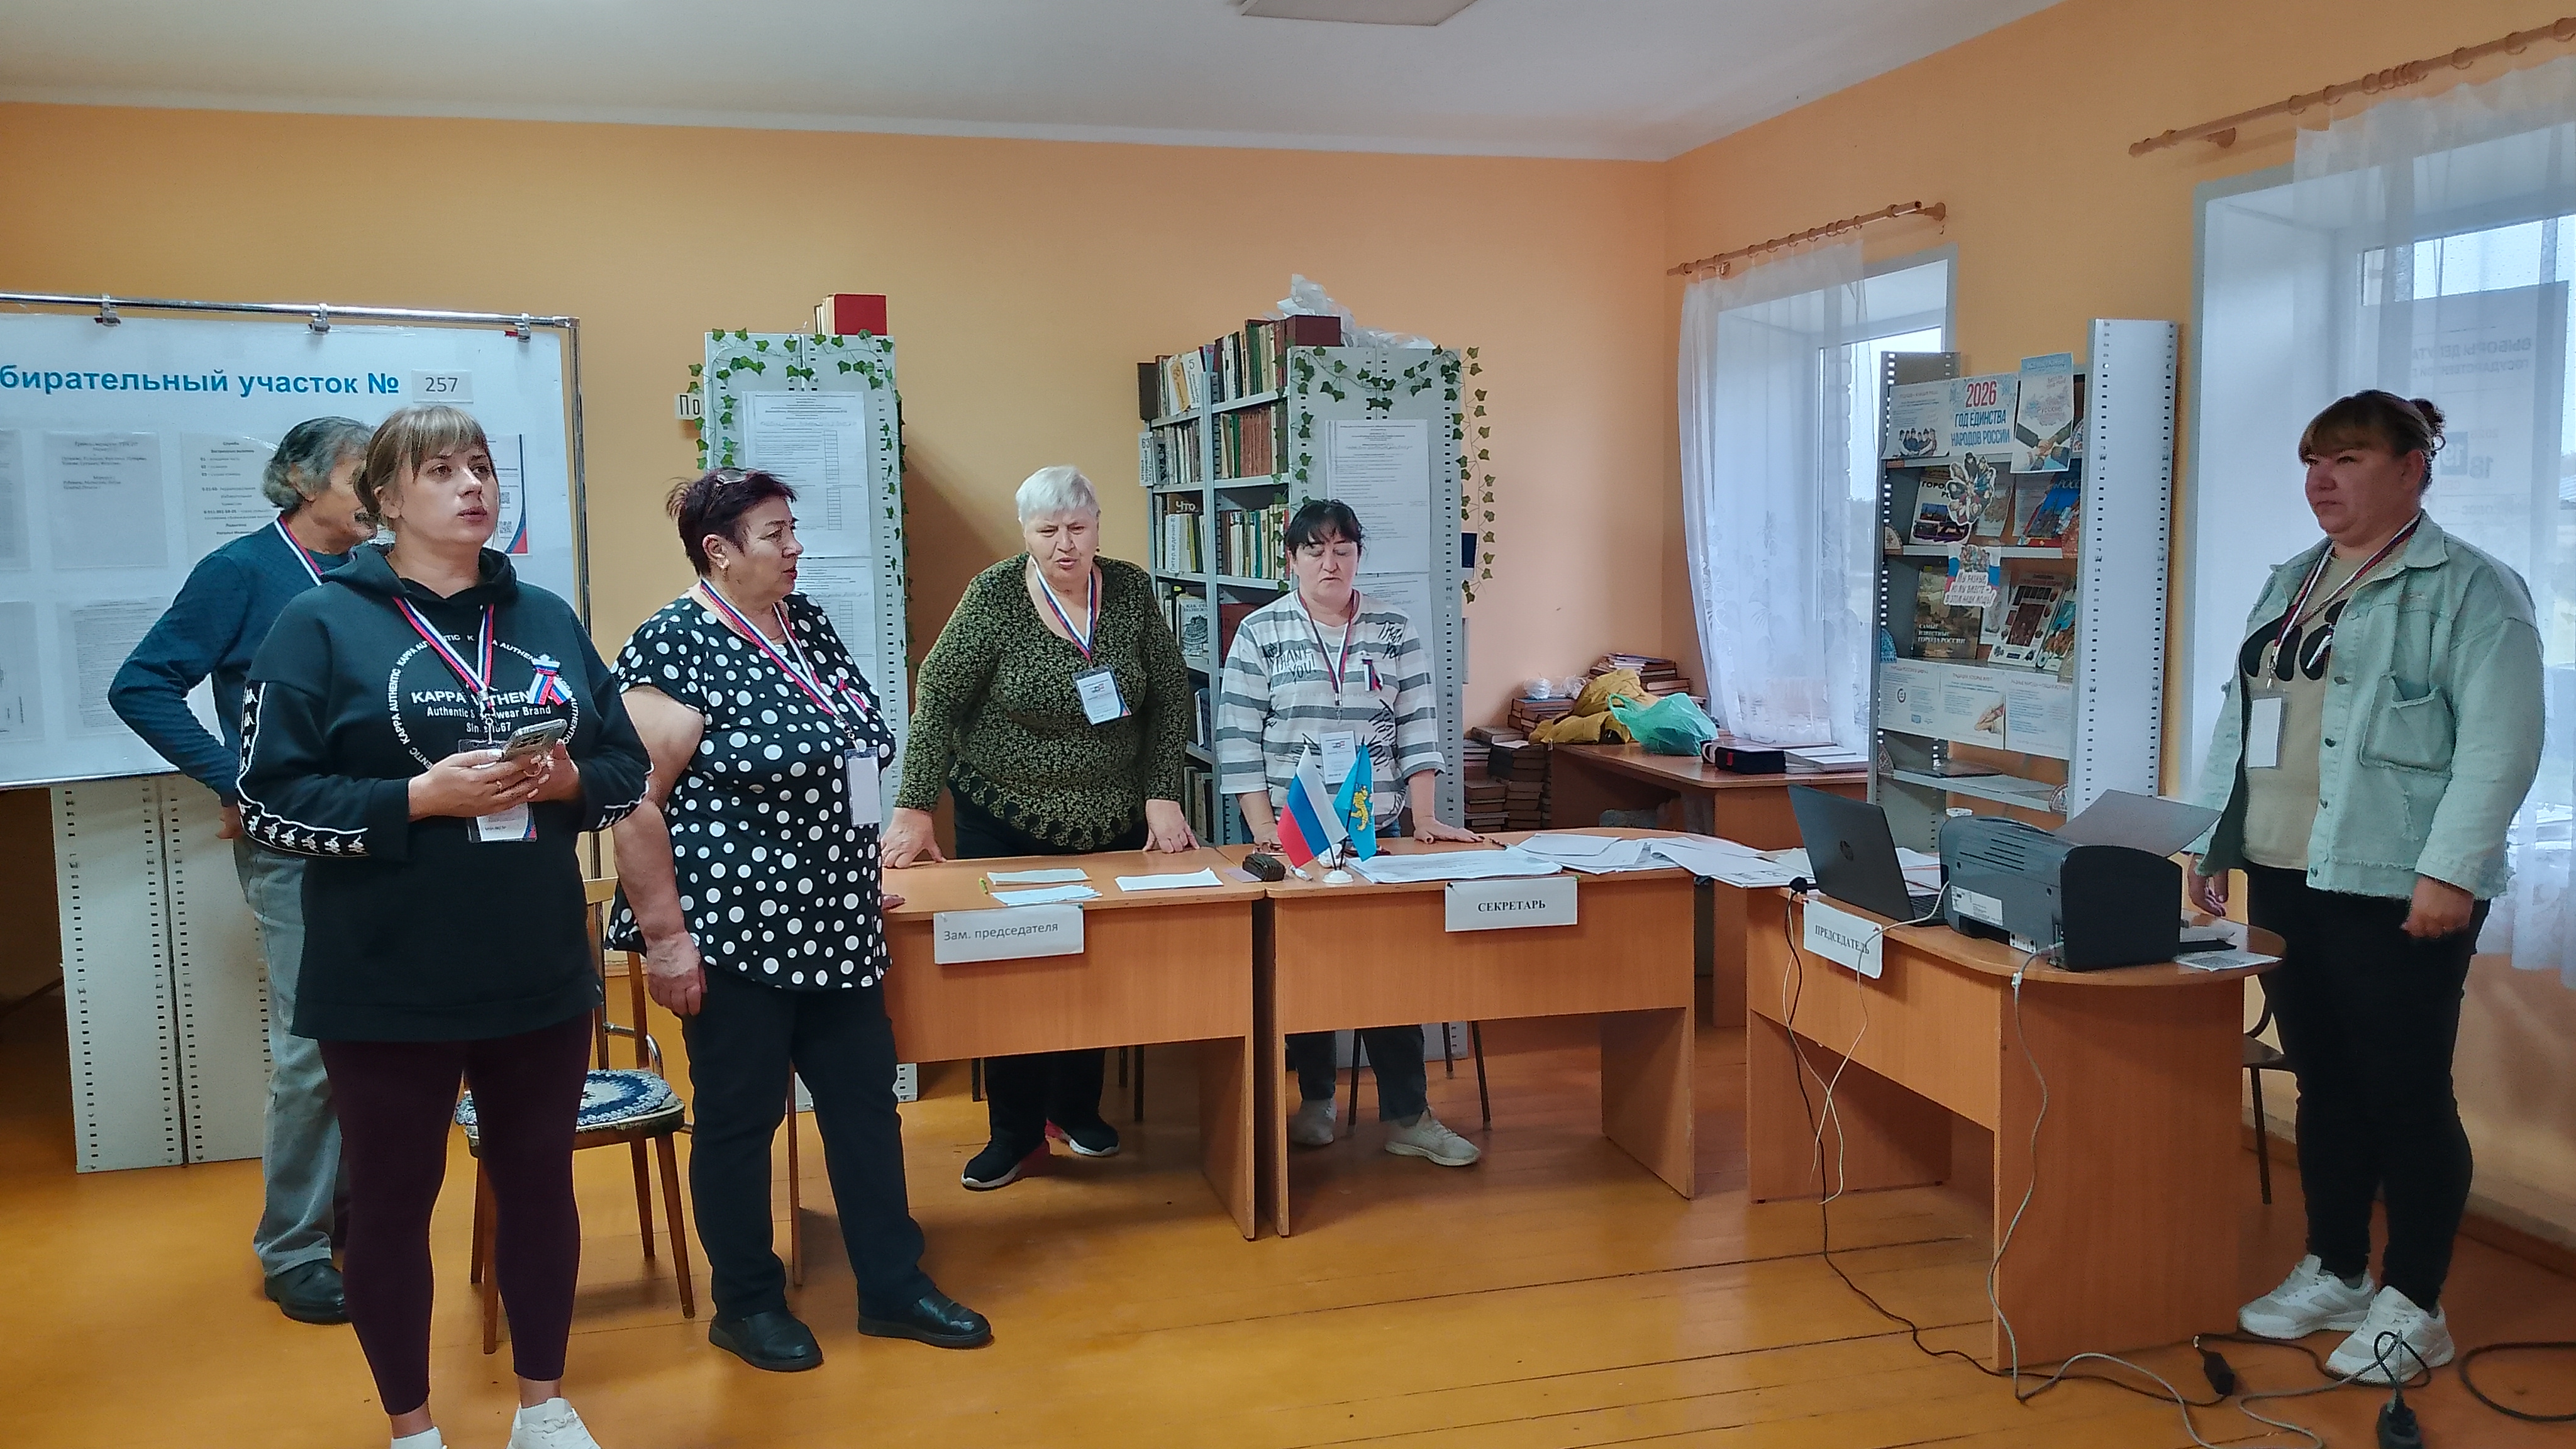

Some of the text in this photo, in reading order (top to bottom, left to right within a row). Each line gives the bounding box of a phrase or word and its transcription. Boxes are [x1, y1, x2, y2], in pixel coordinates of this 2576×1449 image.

[1189, 359, 1195, 369] 5
[0, 365, 458, 397] бирательный участок № 257
[1966, 380, 1997, 408] 2026
[1955, 413, 1968, 428] ГОД
[1970, 409, 2006, 426] ЕДИНСТВА
[1951, 428, 2010, 447] НАРОДОВ РОССИИ
[1922, 480, 1946, 491] ГОРО
[1175, 501, 1196, 511] Что
[397, 648, 418, 667] KAPPA
[1276, 643, 1313, 673] THANK
[1288, 653, 1317, 686] YOU!
[387, 668, 411, 745] KAPPA AUTHENTIC
[411, 690, 531, 706] KAPPA THEN
[426, 707, 469, 718] Authentic
[522, 704, 552, 717] Brand
[466, 722, 488, 733] Sine
[1477, 899, 1546, 913] СЕКРЕТАРЬ
[943, 923, 1058, 941] Зам. председателя
[1815, 924, 1870, 955] ПРЕДСЕДАТЕЛЬ
